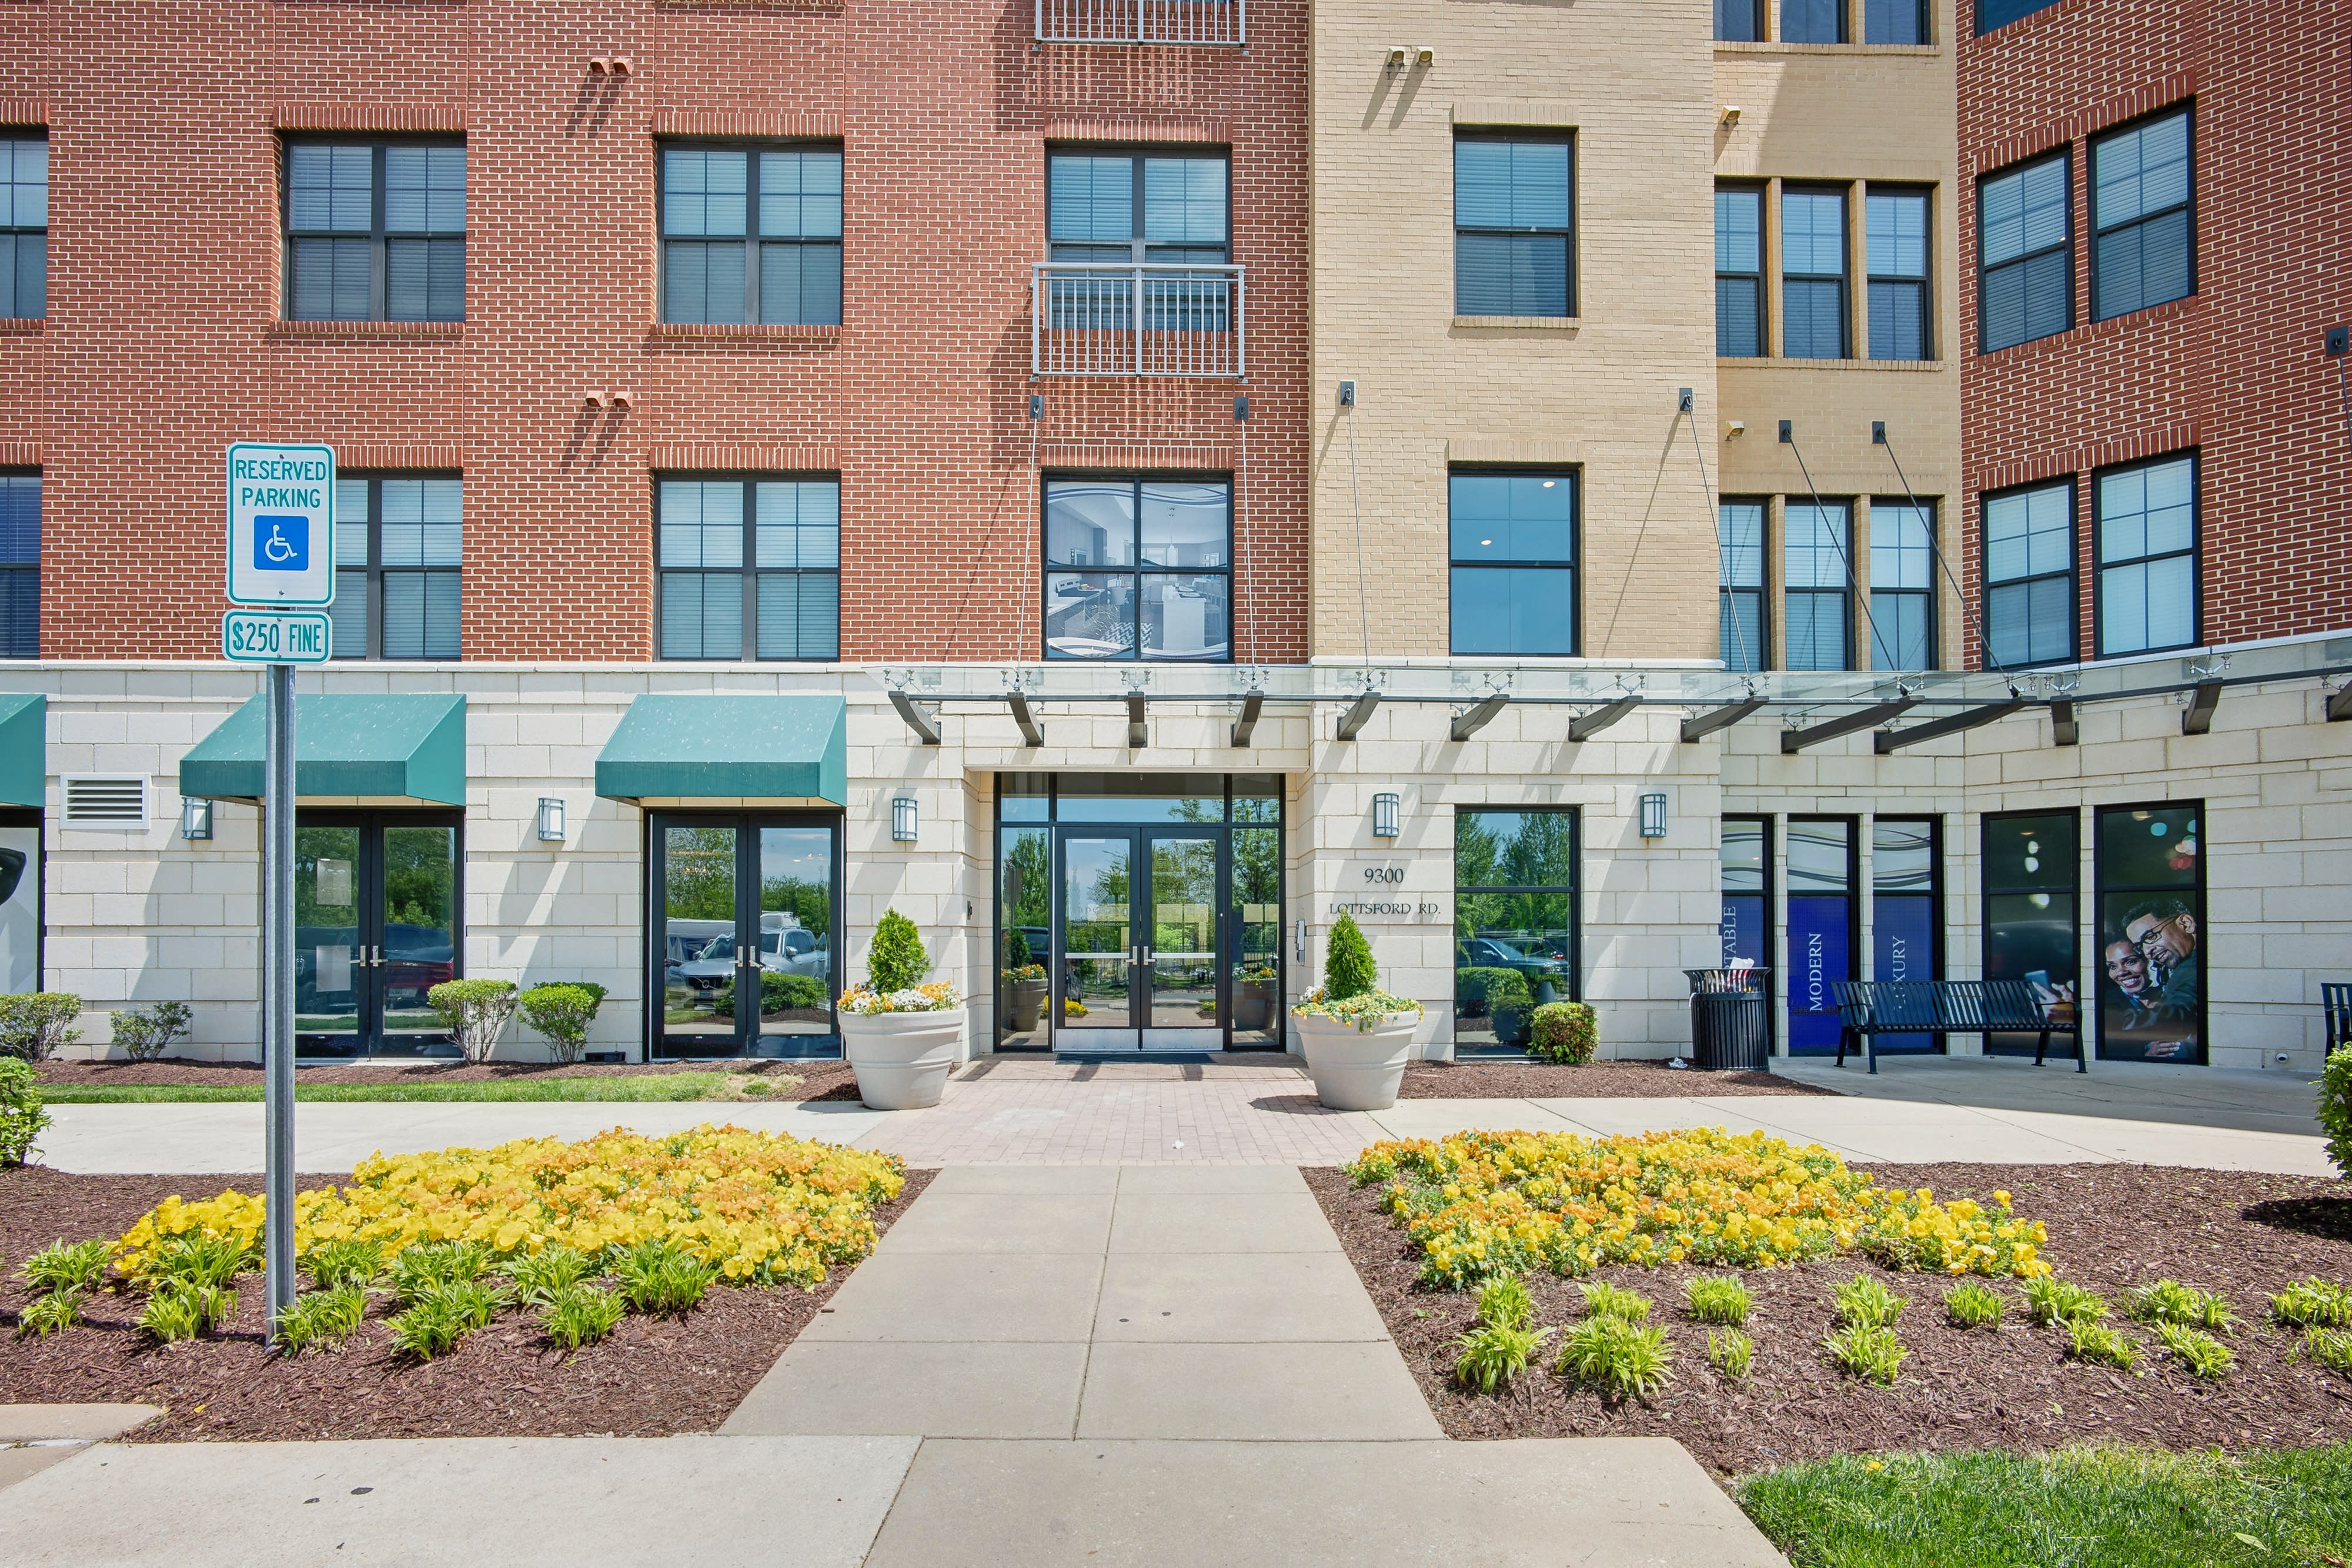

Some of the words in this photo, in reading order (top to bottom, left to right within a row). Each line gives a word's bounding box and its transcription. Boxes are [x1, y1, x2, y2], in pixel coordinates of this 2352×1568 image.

[235, 459, 326, 480] RESERVED
[242, 487, 320, 508] PARKING
[232, 620, 279, 653] $250
[289, 624, 322, 653] FINE
[1364, 868, 1404, 883] 9300
[1329, 903, 1411, 914] LOTTSFORD
[1418, 903, 1441, 914] RD.
[1723, 906, 1736, 968] TABLE
[1809, 932, 1822, 1012] MODERN
[1893, 935, 1906, 1011] XURY
